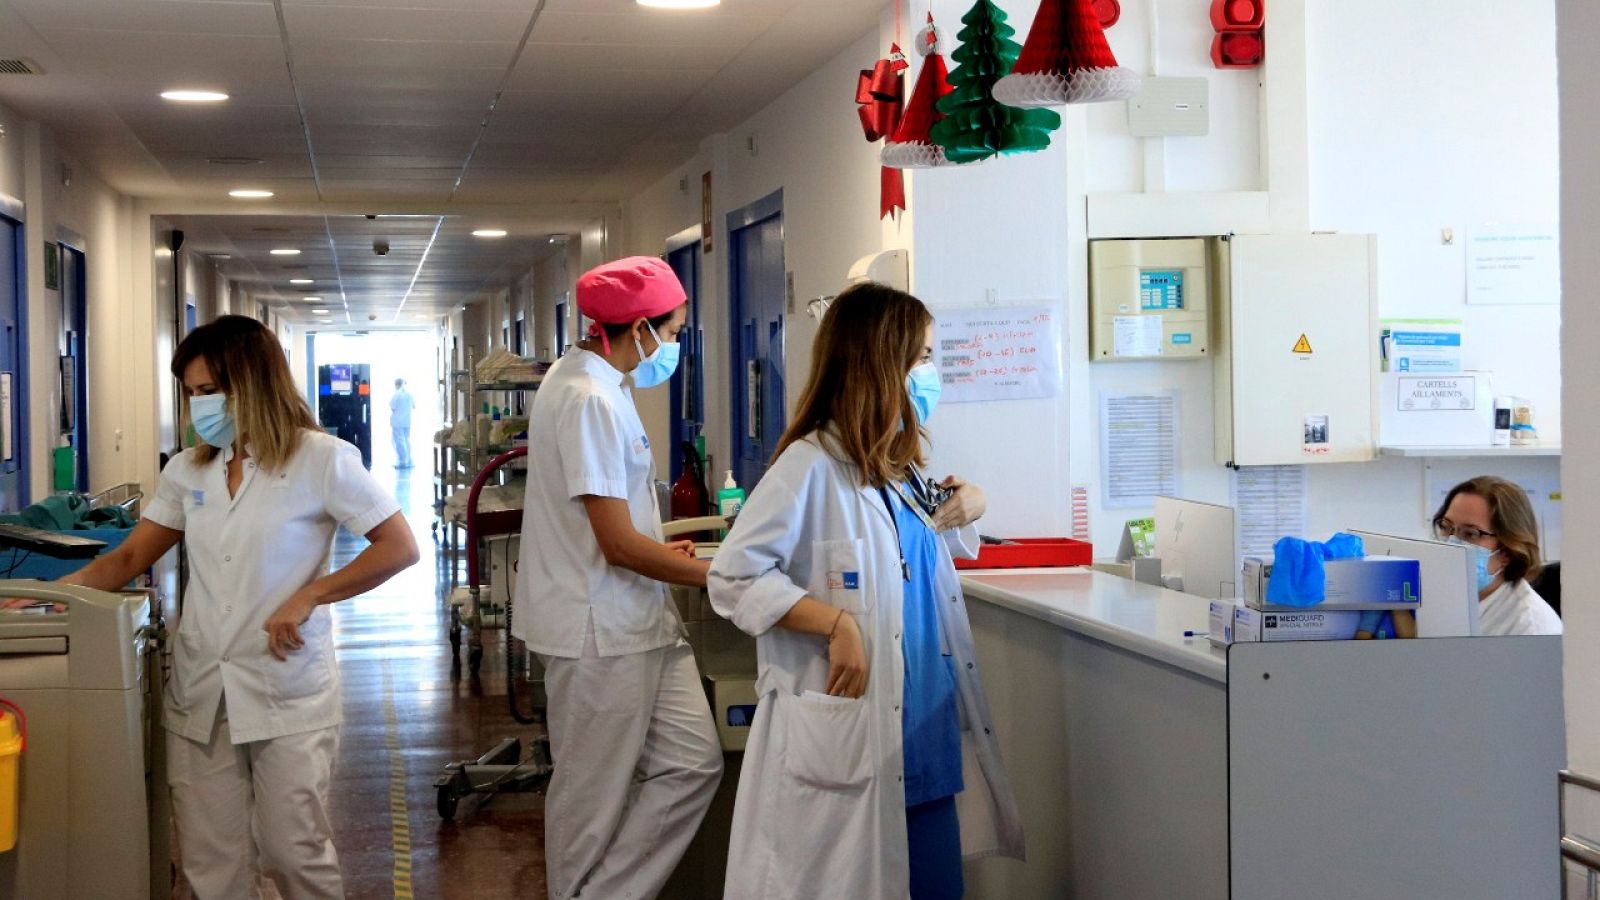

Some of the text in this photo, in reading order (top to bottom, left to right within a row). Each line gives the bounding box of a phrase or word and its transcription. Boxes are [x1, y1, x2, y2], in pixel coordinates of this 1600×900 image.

[1416, 380, 1457, 388] CARTELLS
[1403, 581, 1417, 601] L
[1279, 614, 1325, 622] MEDIGUARD
